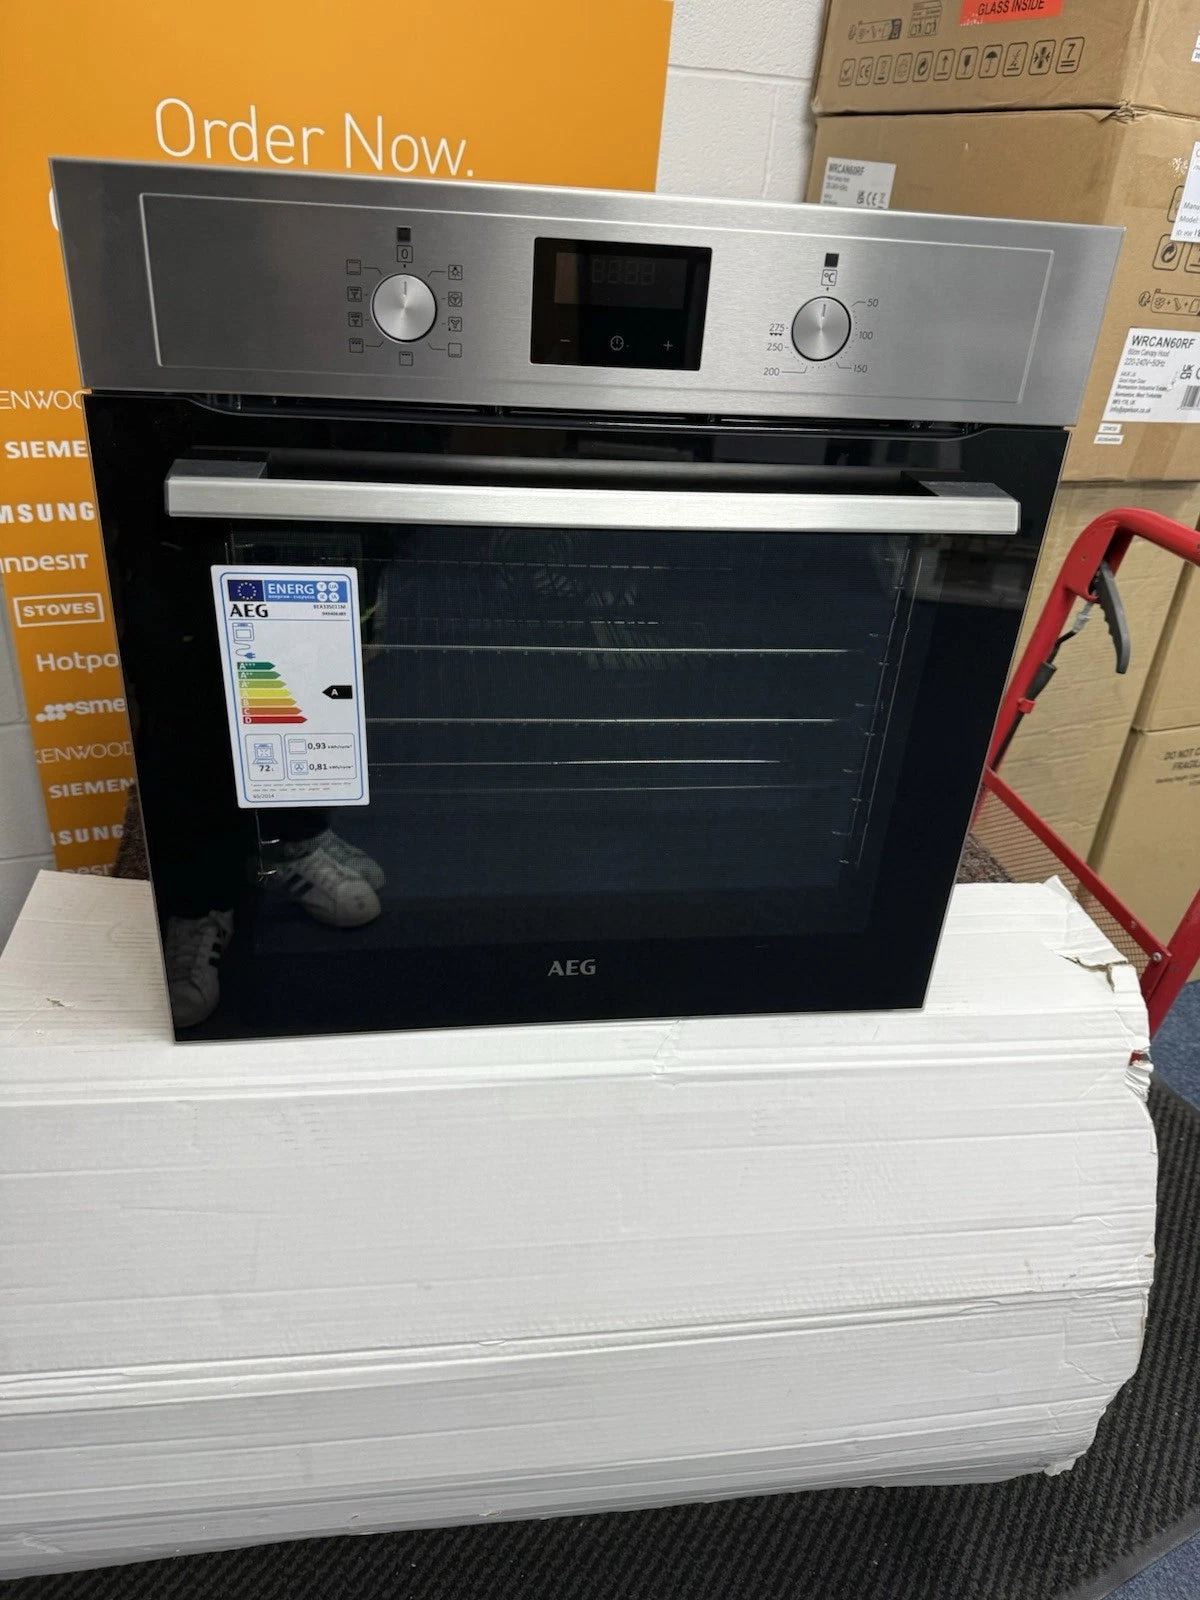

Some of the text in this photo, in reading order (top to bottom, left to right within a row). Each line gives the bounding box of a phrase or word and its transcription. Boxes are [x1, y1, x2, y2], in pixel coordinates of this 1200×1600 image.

[977, 0, 1045, 16] GLASS INSIDE
[155, 97, 474, 176] Order Now.
[866, 297, 879, 308] 50
[769, 323, 785, 333] 275
[858, 330, 874, 341] 100
[1131, 335, 1196, 349] WRCAN60RF
[766, 343, 784, 352] 250
[763, 367, 780, 376] 200
[853, 364, 868, 373] 150
[4, 440, 89, 459] SIEME
[0, 501, 95, 524] MSUNG
[268, 583, 315, 595] ENERG
[23, 602, 96, 618] STOVES
[230, 603, 269, 618] AEG
[36, 652, 119, 673] Hotpo
[331, 688, 339, 696] A
[75, 698, 126, 715] sme
[307, 742, 327, 751] 0,93
[308, 763, 328, 772] 0,81
[547, 959, 597, 977] AEG
